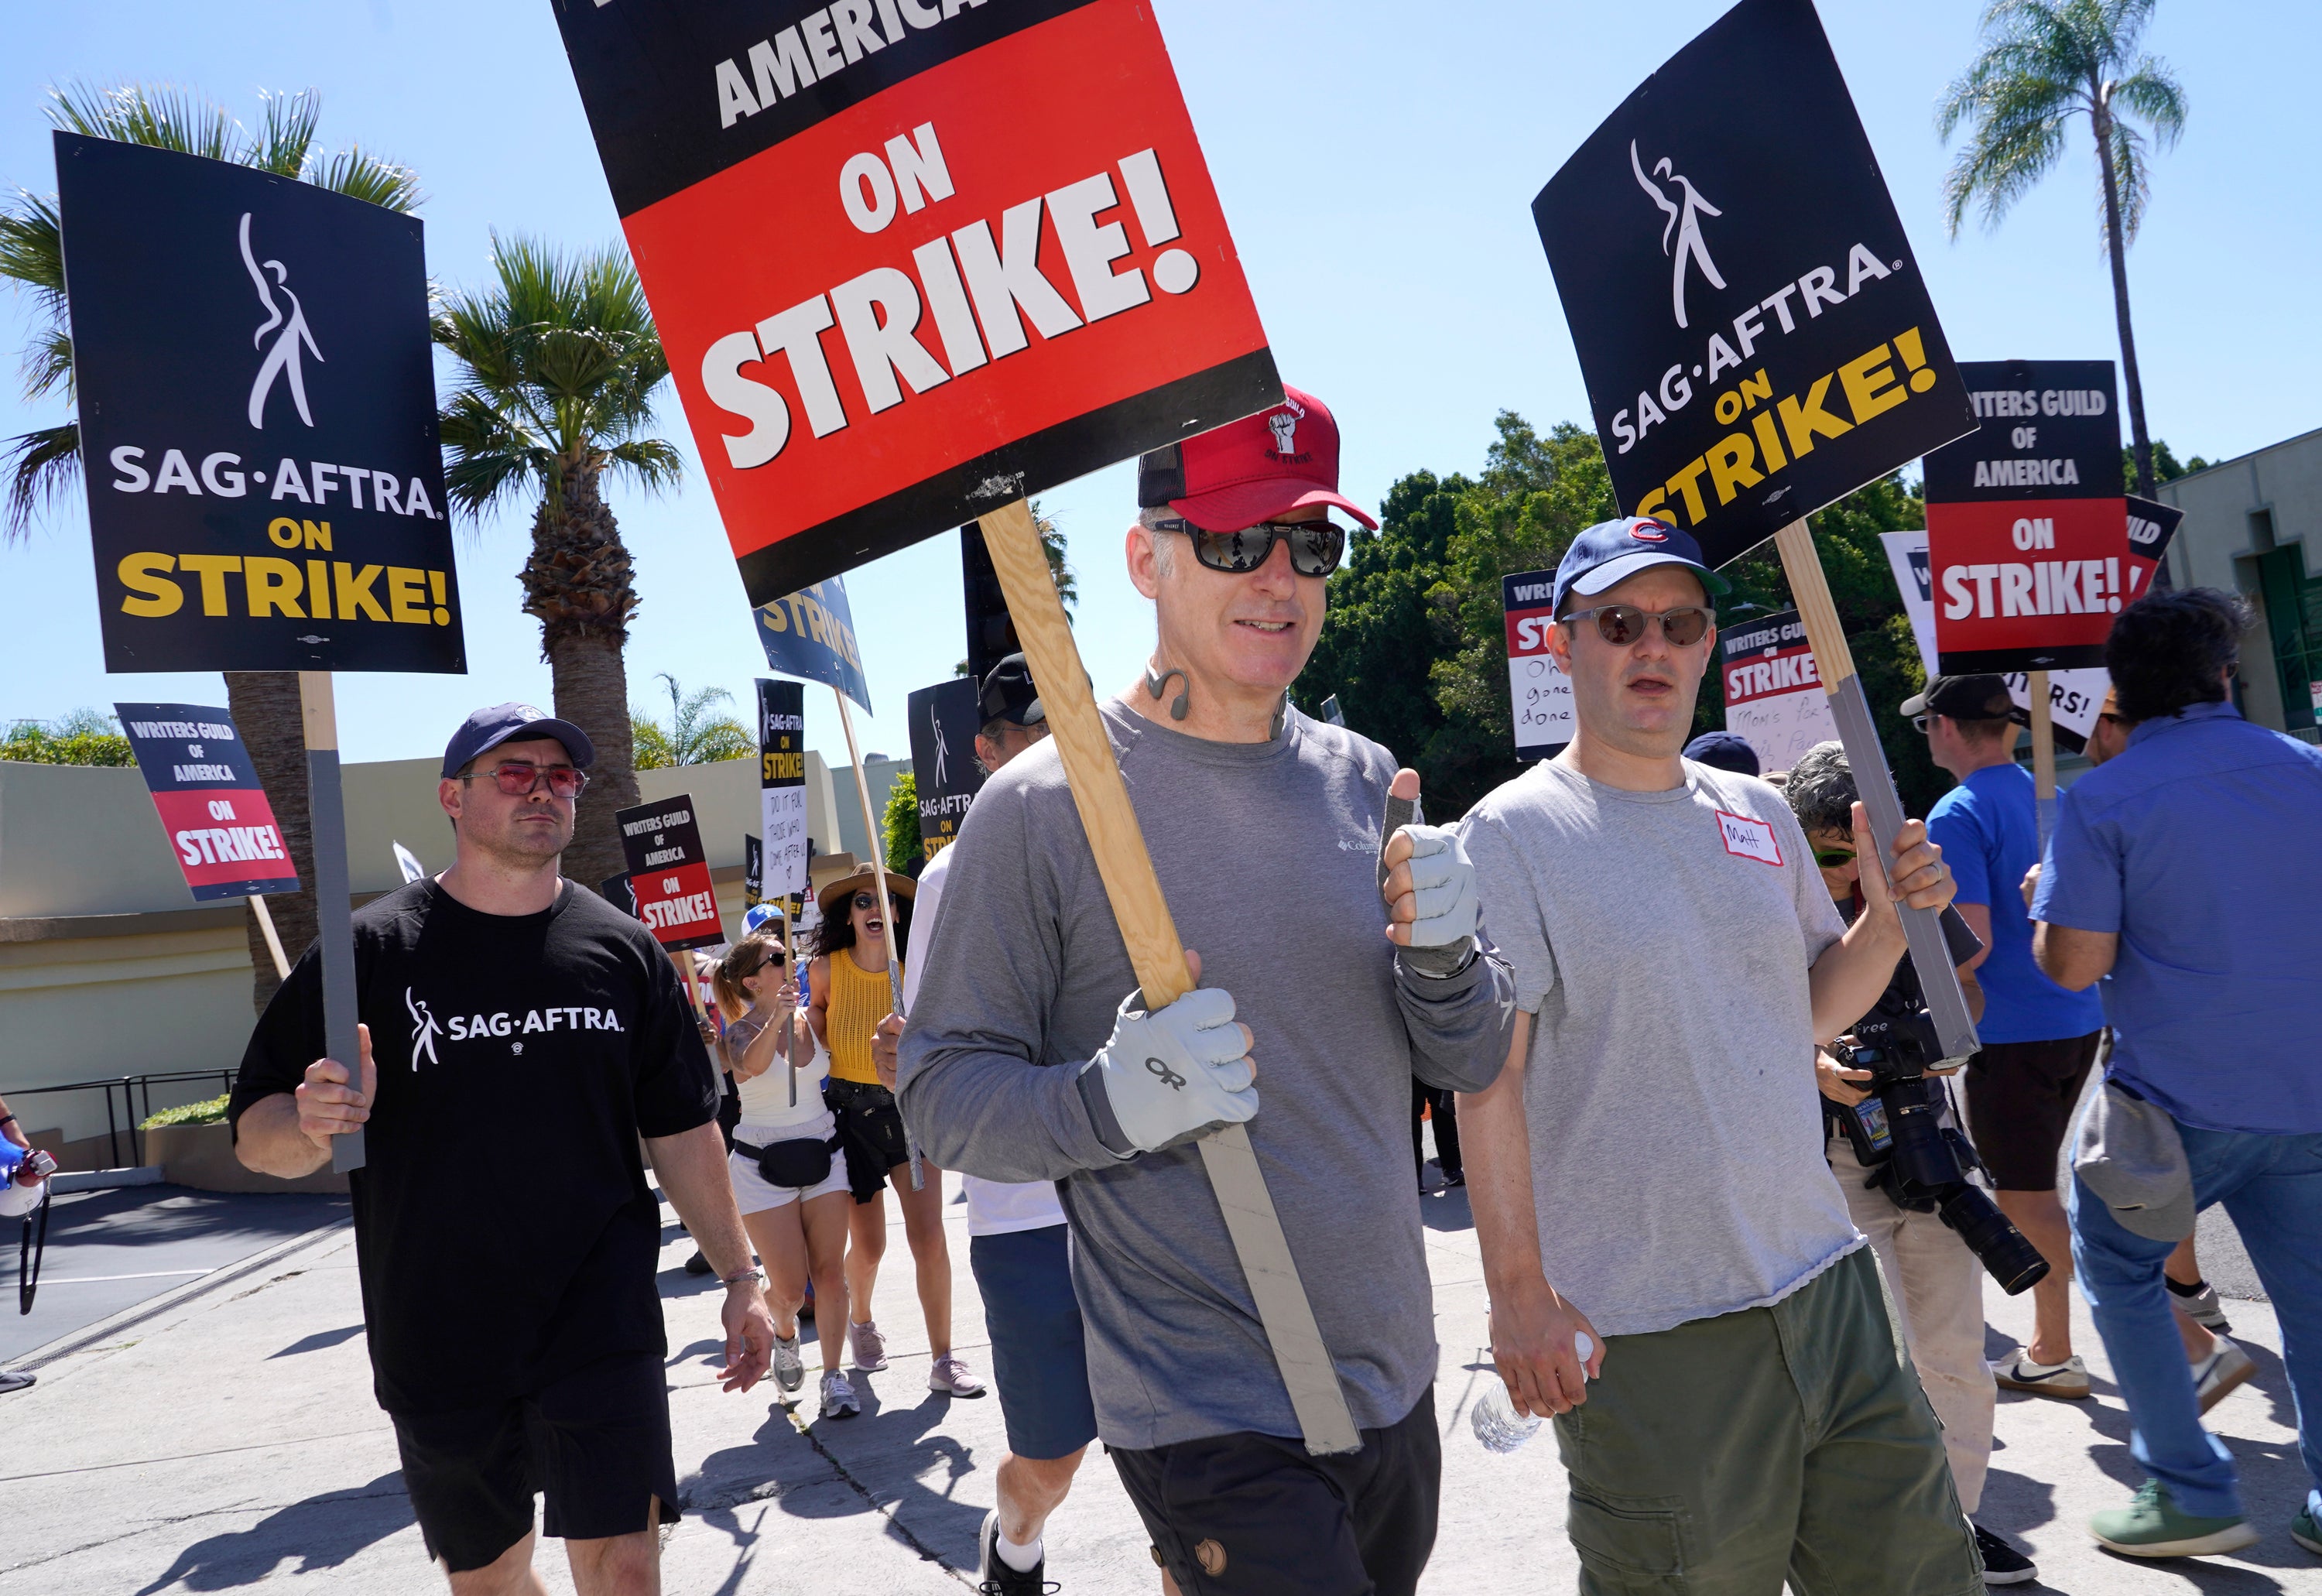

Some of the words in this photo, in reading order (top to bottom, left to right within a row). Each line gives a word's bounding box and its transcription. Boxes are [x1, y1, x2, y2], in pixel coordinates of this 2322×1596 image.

[714, 0, 988, 129] AMERI
[838, 121, 955, 234] ON
[700, 147, 1200, 470] STRIKE!
[1714, 368, 1773, 425] ON
[1968, 390, 2039, 417] ITERS
[2041, 389, 2107, 416] GUILD
[1635, 326, 1937, 529] STRIKE!
[2012, 426, 2037, 450] OF
[1974, 458, 2080, 488] AMERICA
[267, 518, 333, 552] ON
[2012, 518, 2055, 551] ON
[118, 551, 450, 626] STRIKE!
[1942, 557, 2122, 621] STRIKE!
[1725, 627, 1779, 655] WRITERS
[1764, 646, 1778, 658] ON
[1728, 652, 1821, 700] STRIKE
[1527, 685, 1571, 707] gone
[1521, 708, 1571, 725] done
[130, 721, 197, 739] WRITERS
[197, 722, 235, 741] GUILD
[780, 736, 790, 749] ON
[187, 744, 204, 759] OF
[173, 764, 236, 782] AMERICA
[207, 800, 236, 821] ON
[920, 793, 978, 817] SAG·AFTR
[623, 816, 663, 837] WRITERS
[662, 810, 691, 828] GUILD
[940, 820, 953, 833] ON
[1726, 824, 1759, 849] Matt
[176, 825, 285, 866] STRIKE!
[654, 834, 665, 847] OF
[645, 846, 686, 867] AMERICA
[663, 876, 681, 895] ON
[643, 891, 715, 930] STRIKE!
[1858, 1022, 1888, 1034] ree
